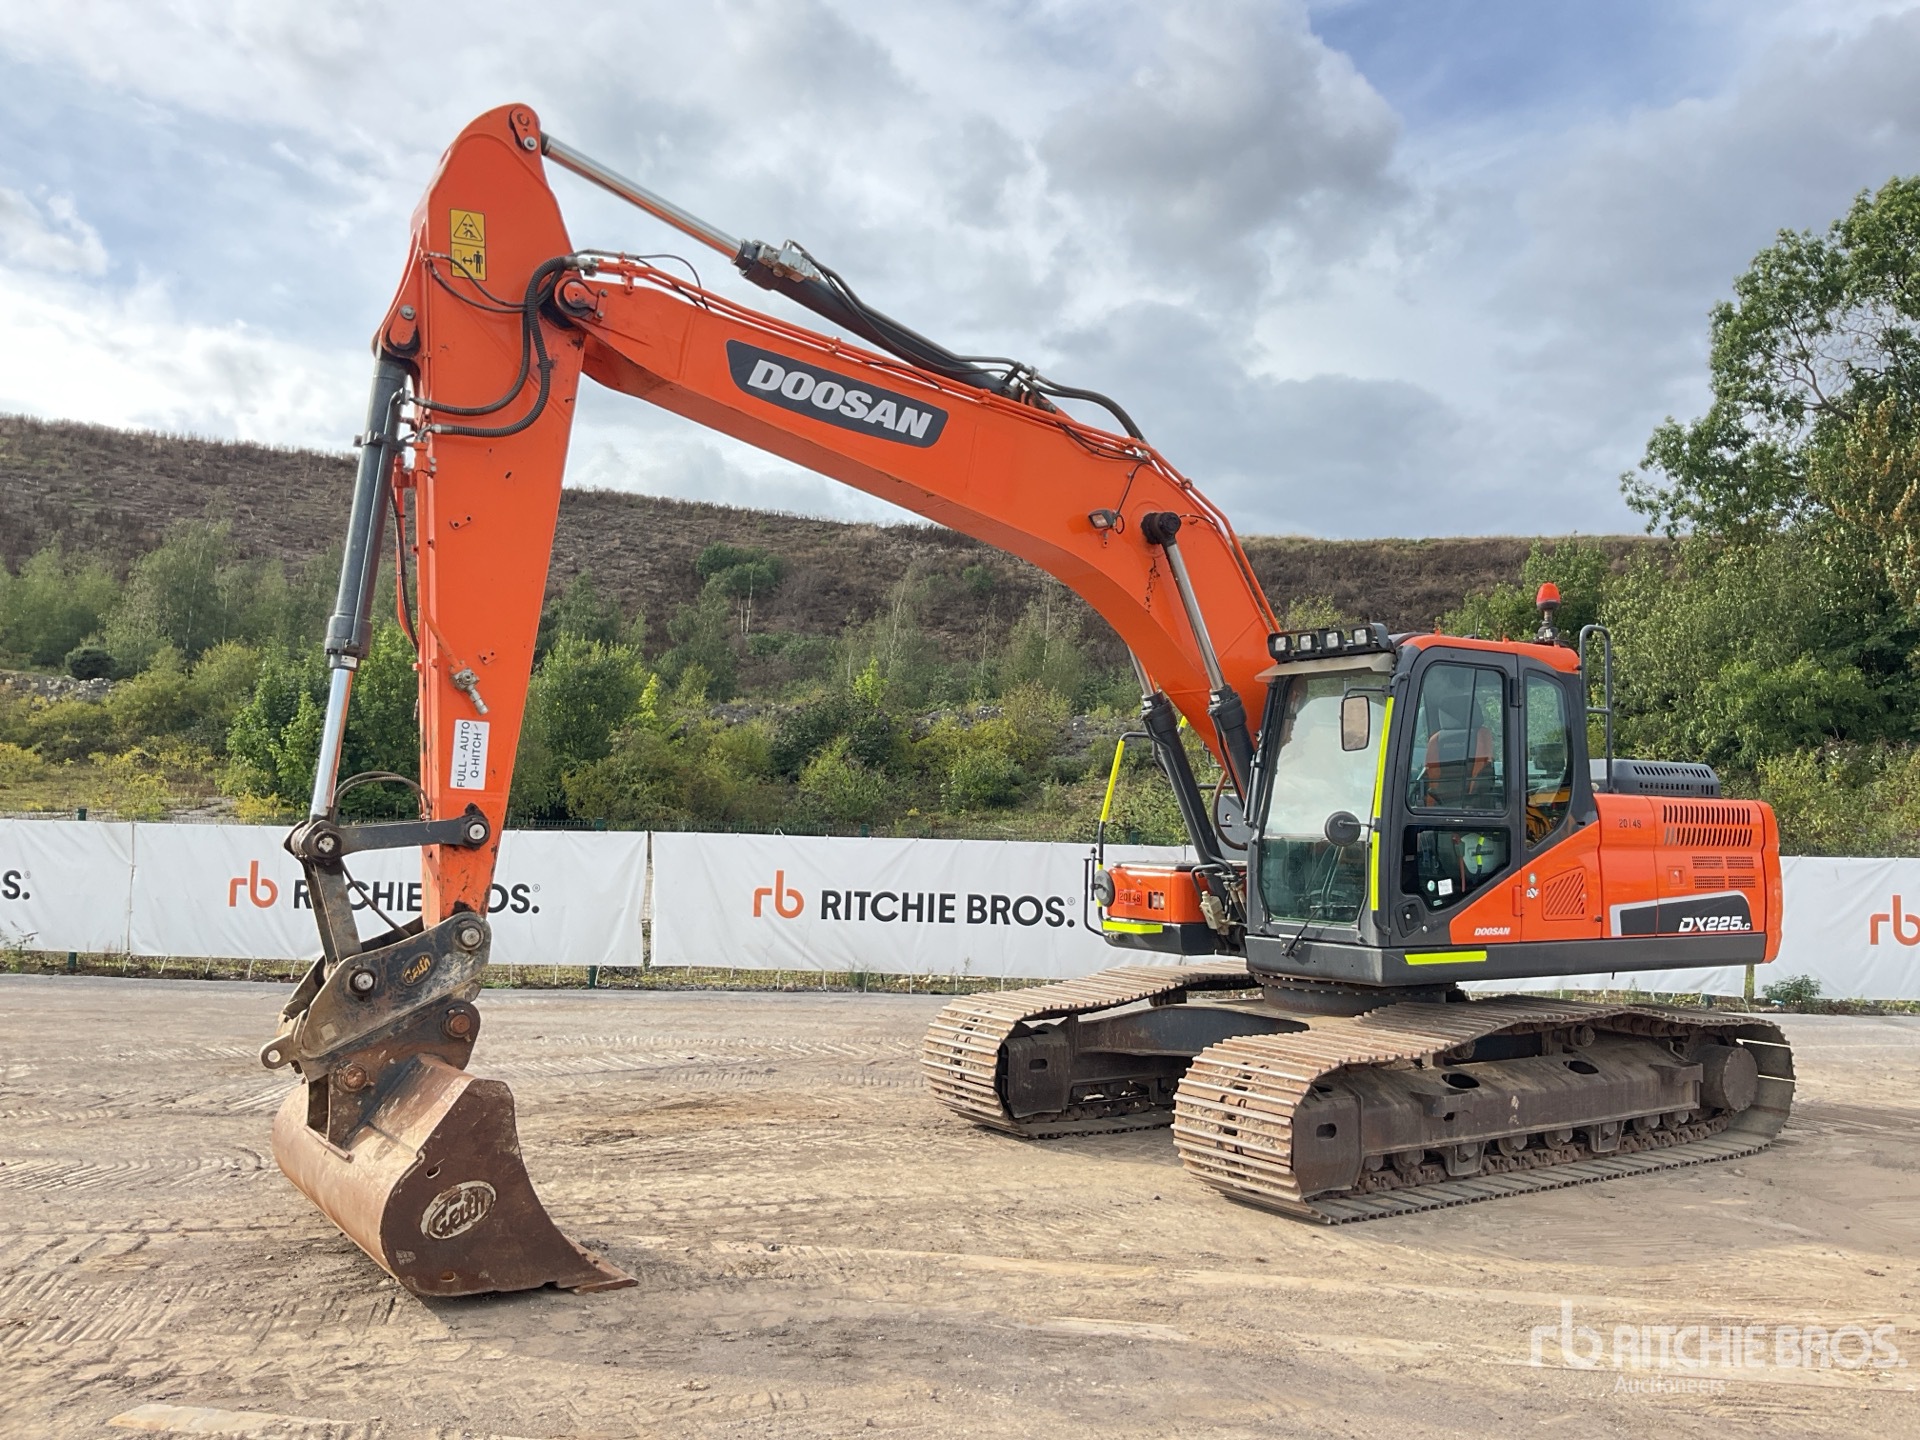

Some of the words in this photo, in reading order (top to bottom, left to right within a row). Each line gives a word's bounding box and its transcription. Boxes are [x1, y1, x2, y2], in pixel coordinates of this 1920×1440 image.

[747, 359, 933, 439] DOOSAN
[459, 721, 471, 751] AUTO
[470, 732, 482, 779] Q-HITCH
[456, 761, 468, 788] FULL
[229, 860, 279, 909] rb
[293, 879, 422, 912] RCHIE
[487, 883, 540, 914] OS.
[753, 870, 805, 919] rb
[820, 889, 956, 924] RITCHIE
[966, 893, 1076, 929] BROS.
[1474, 926, 1511, 937] DOOSAN
[1870, 894, 1920, 947] rb
